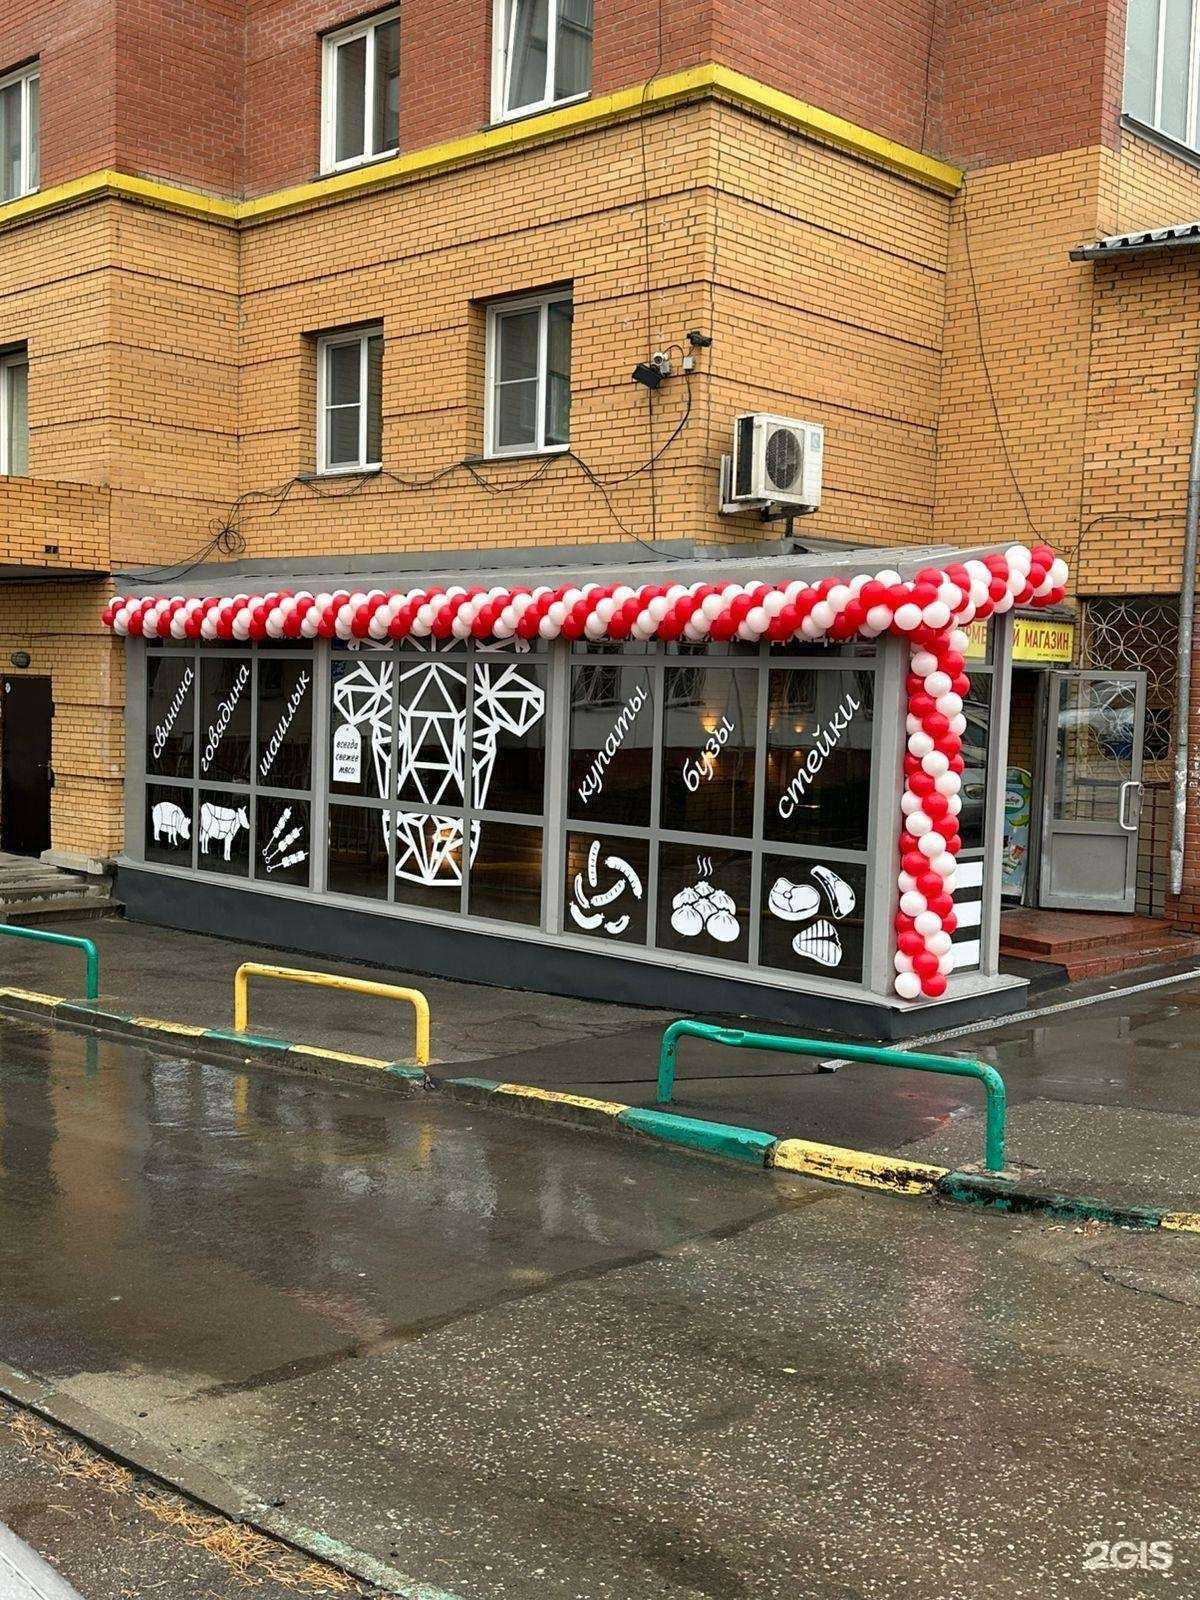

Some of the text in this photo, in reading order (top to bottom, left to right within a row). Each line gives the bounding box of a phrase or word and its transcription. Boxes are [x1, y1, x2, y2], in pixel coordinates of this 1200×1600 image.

[1024, 628, 1070, 651] МАГАЗИН
[152, 666, 195, 759] свинина
[201, 664, 250, 772] говядина
[259, 670, 310, 777] шашлык
[576, 685, 648, 804] купаты
[682, 715, 736, 792] бузы
[778, 693, 860, 819] стейки
